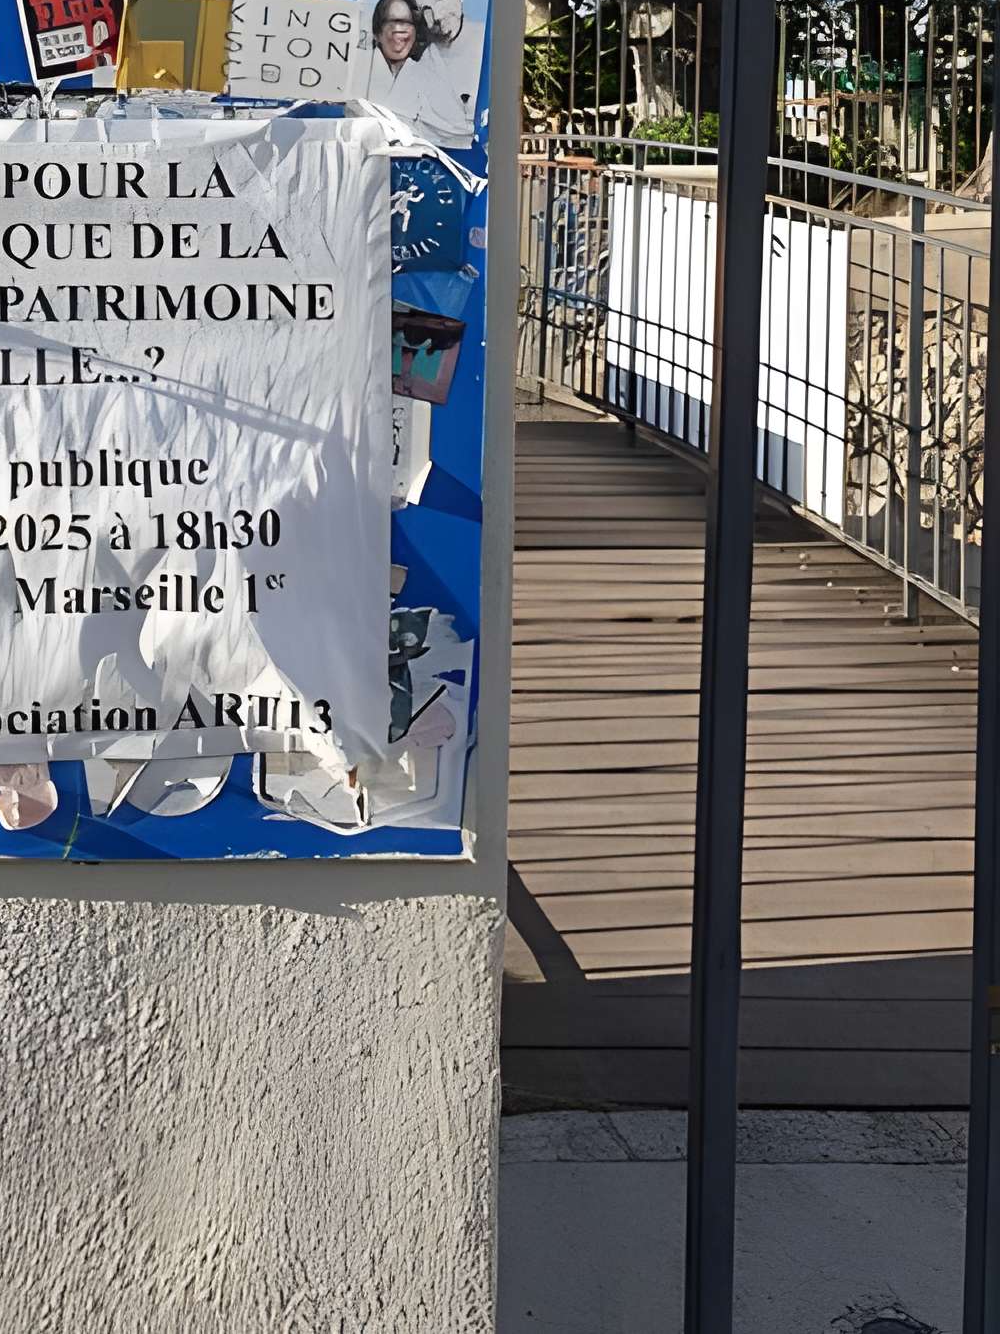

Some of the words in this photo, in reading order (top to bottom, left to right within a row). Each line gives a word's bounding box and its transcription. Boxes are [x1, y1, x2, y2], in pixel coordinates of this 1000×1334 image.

[2, 161, 150, 200] POUR
[166, 161, 236, 199] LA
[132, 222, 200, 259] DE
[218, 223, 289, 260] LA
[9, 448, 210, 499] publique
[109, 512, 131, 551] à
[154, 508, 281, 551] 18h30
[15, 574, 225, 615] Marseille
[246, 573, 287, 613] 1er
